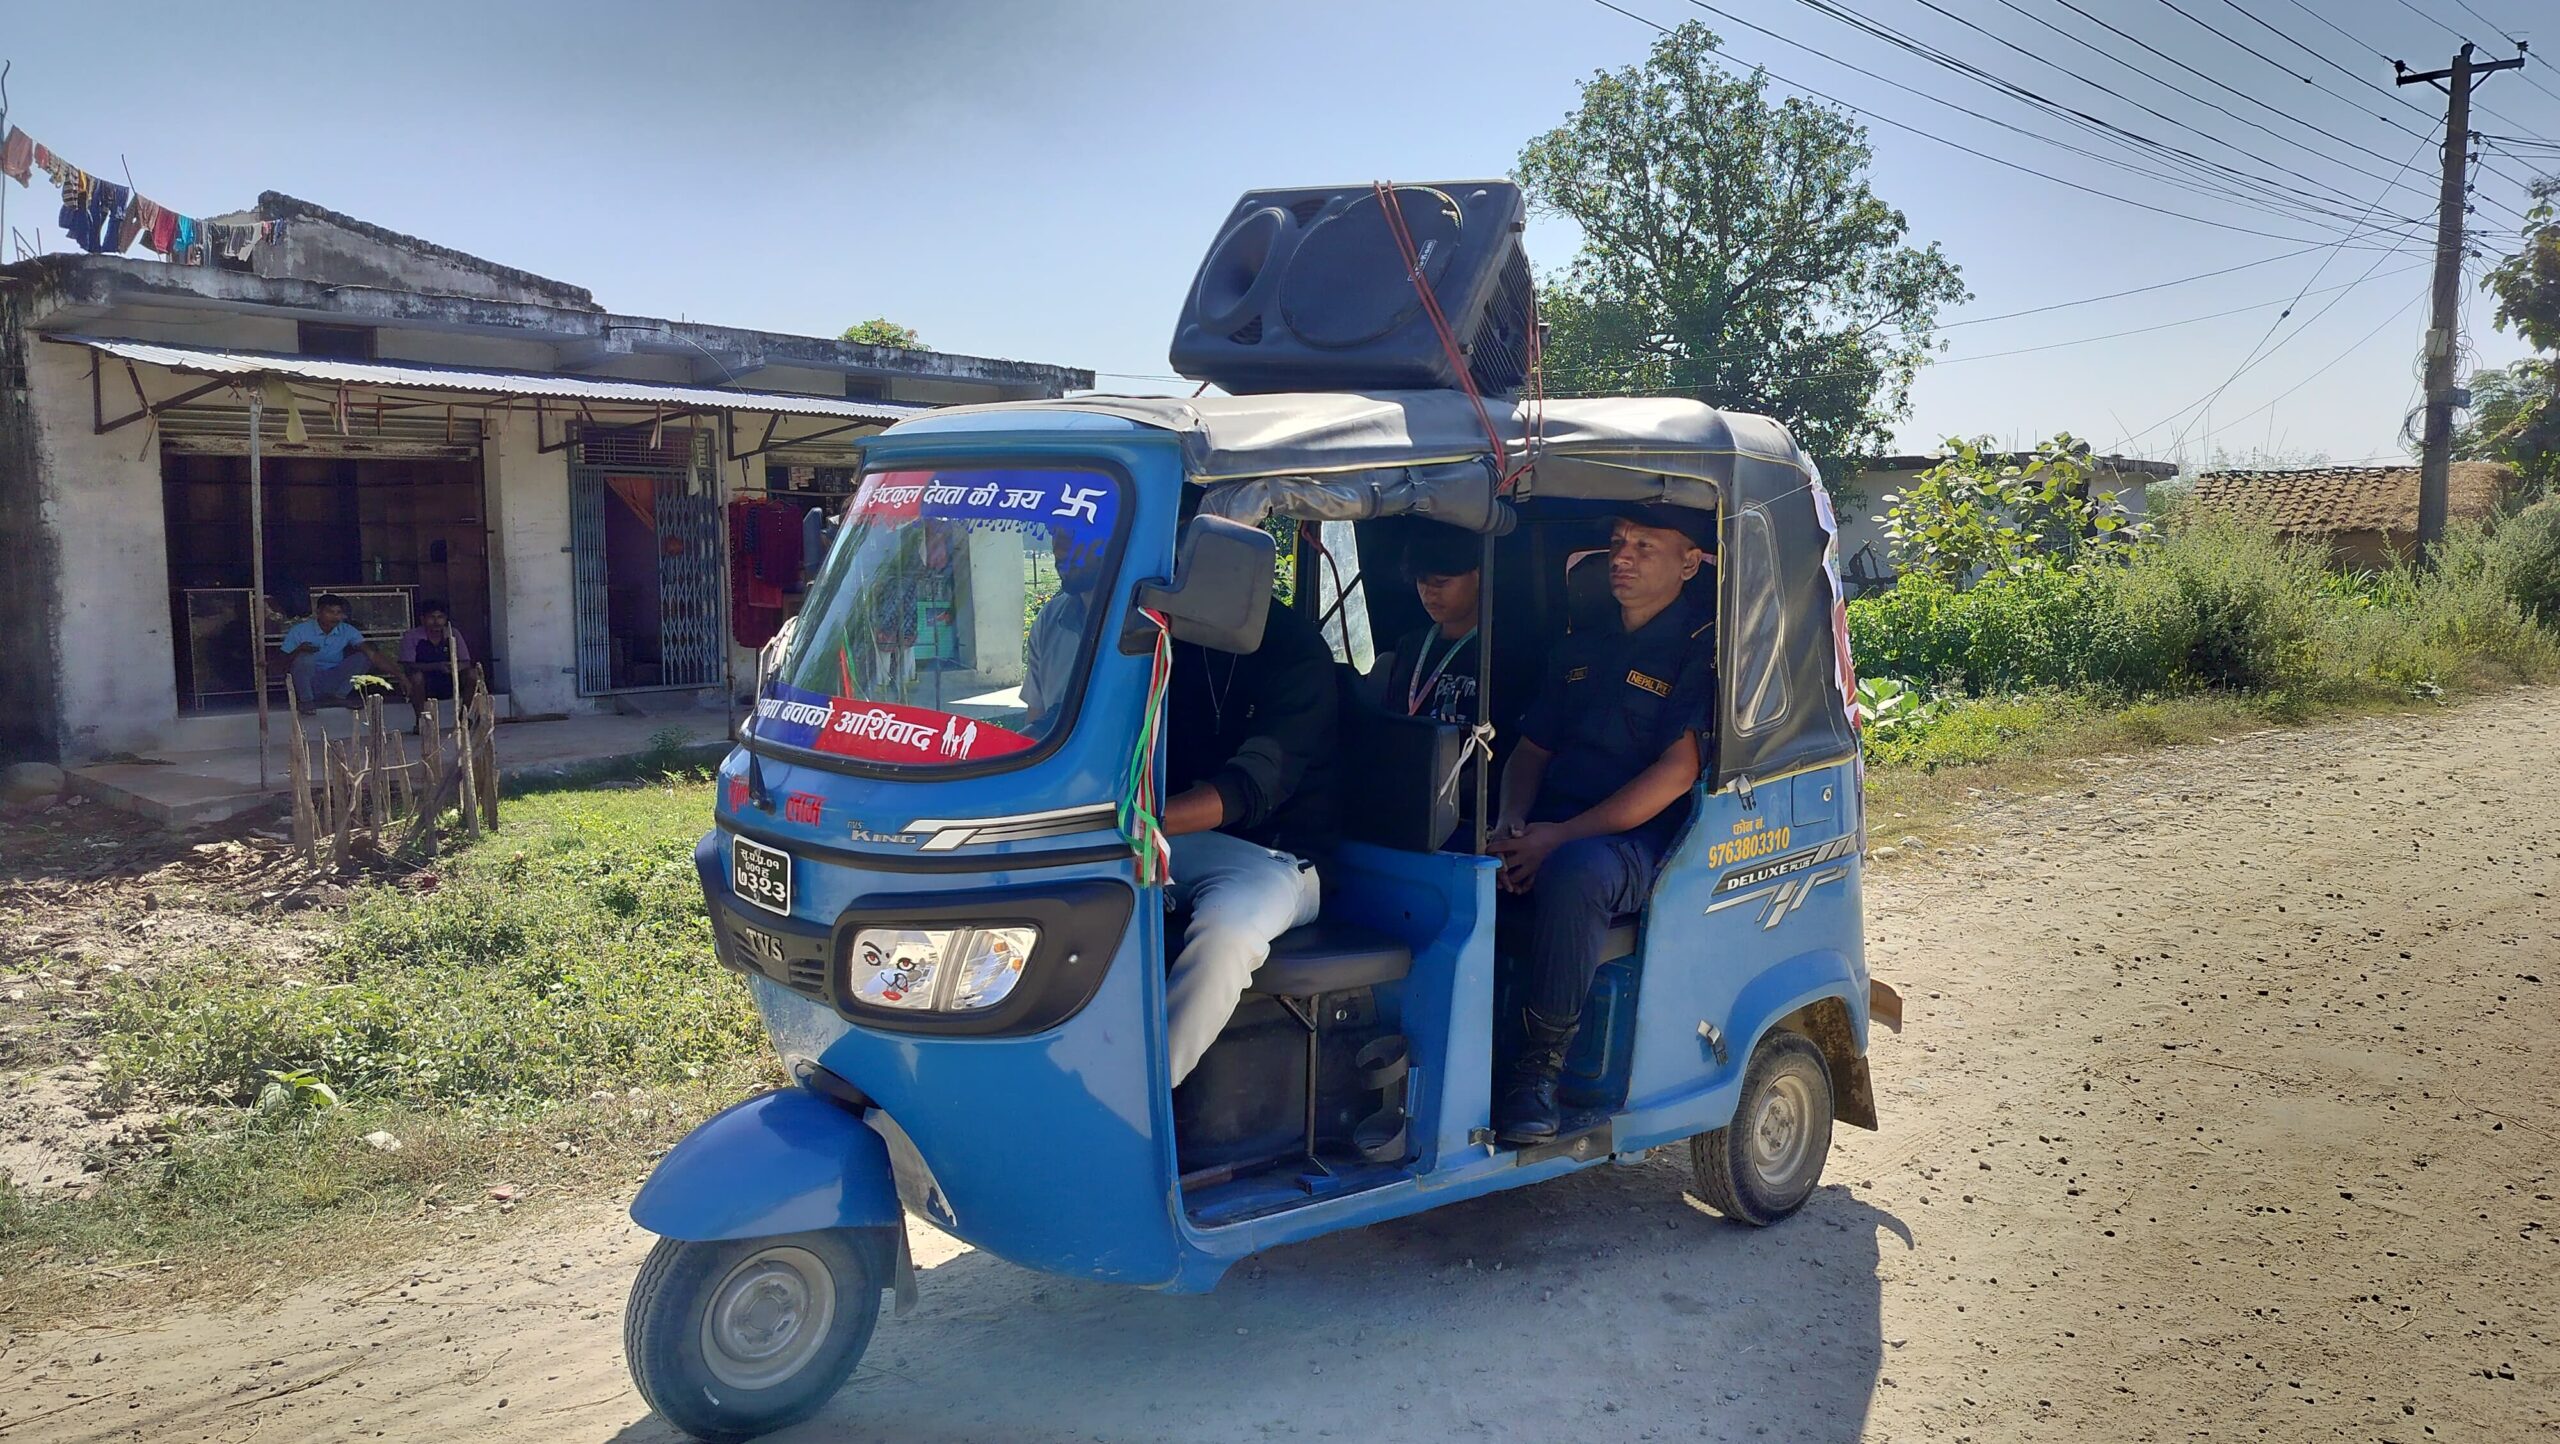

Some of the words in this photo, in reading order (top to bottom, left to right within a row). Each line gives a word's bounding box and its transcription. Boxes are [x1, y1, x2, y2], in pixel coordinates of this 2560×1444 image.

[924, 480, 969, 506] देवता
[968, 482, 999, 507] की
[999, 488, 1046, 510] जय
[1630, 673, 1655, 690] NEPAL
[834, 708, 939, 751] आर्शिवाद
[851, 829, 917, 845] KING
[1708, 826, 1791, 869] 9763803310
[1727, 862, 1790, 890] DELUXE
[1789, 859, 1811, 873] PLUS
[746, 927, 785, 961] TVS
